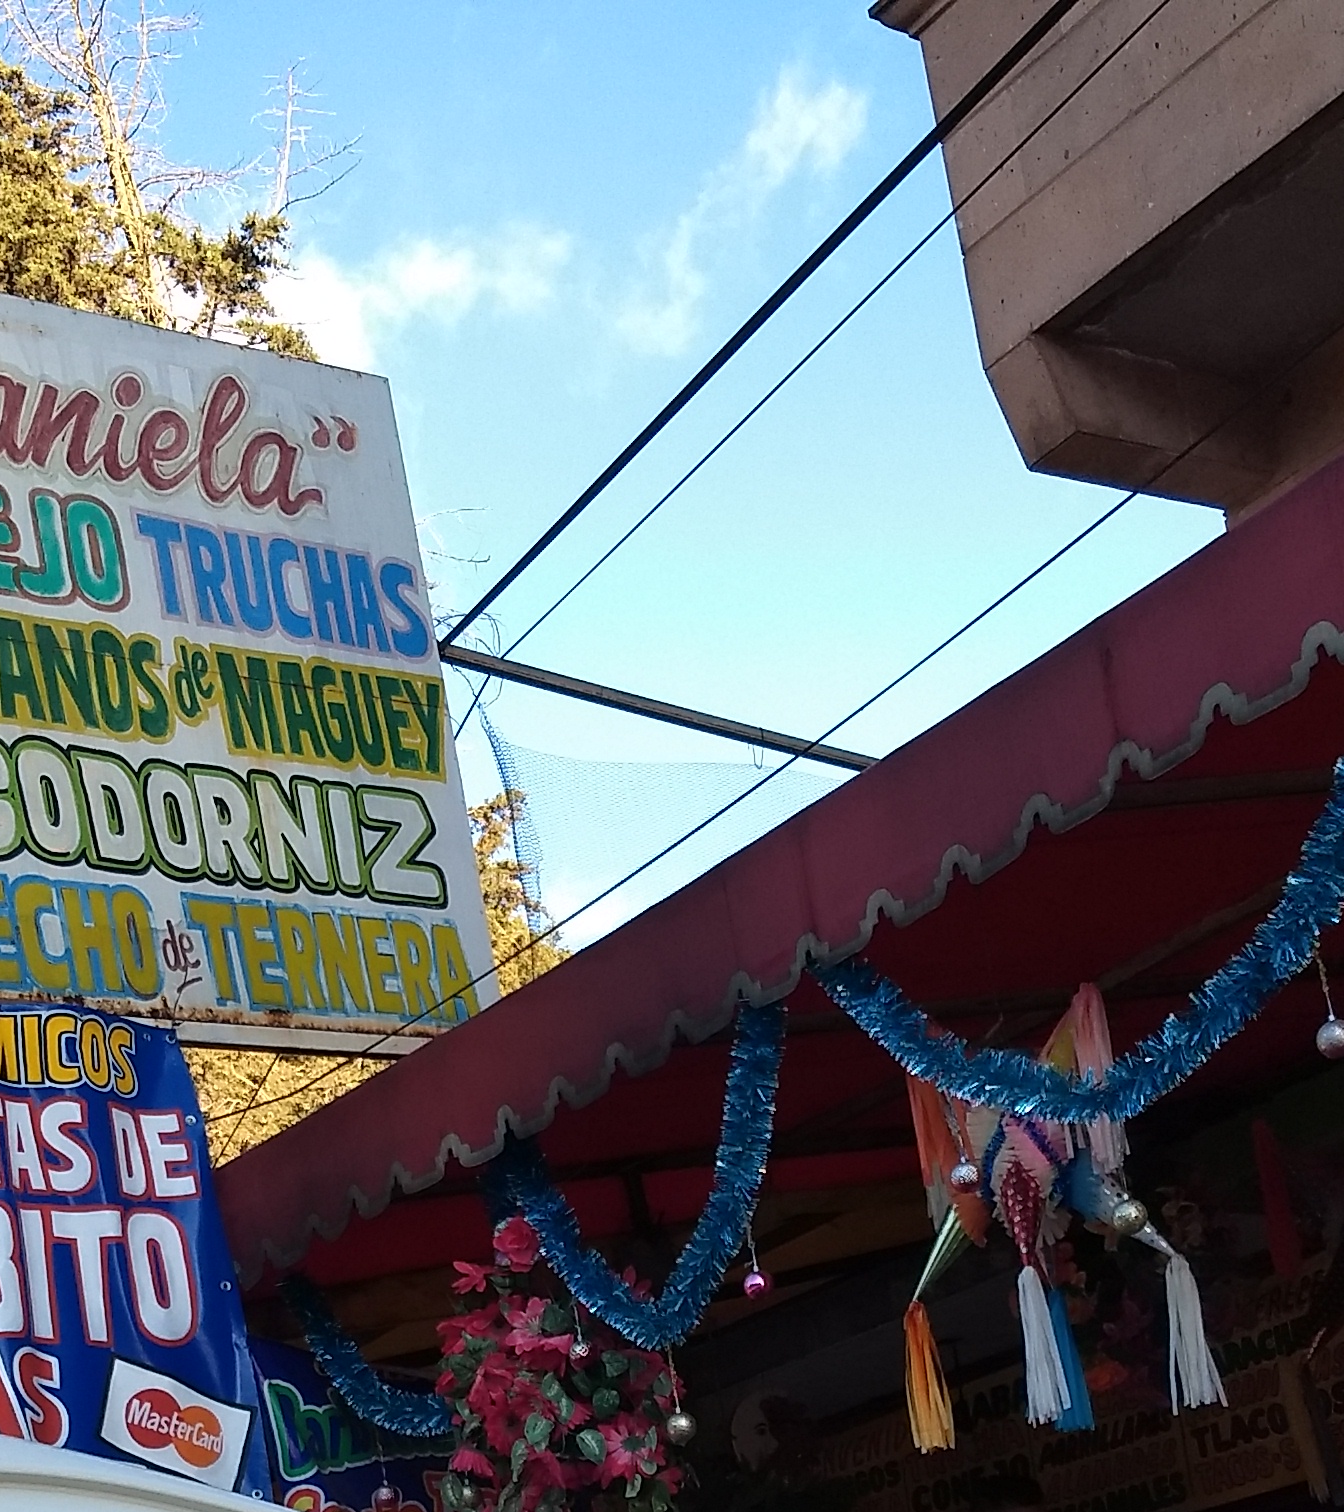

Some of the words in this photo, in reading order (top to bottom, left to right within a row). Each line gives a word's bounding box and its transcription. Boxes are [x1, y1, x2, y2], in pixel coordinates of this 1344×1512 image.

[131, 507, 436, 666] TRUCHAS
[172, 636, 212, 726] de
[208, 644, 447, 781] MAGUEY
[162, 921, 202, 978] de
[184, 892, 481, 1026] TERNERA
[111, 1103, 199, 1201] DE
[127, 1398, 223, 1453] MasterCard
